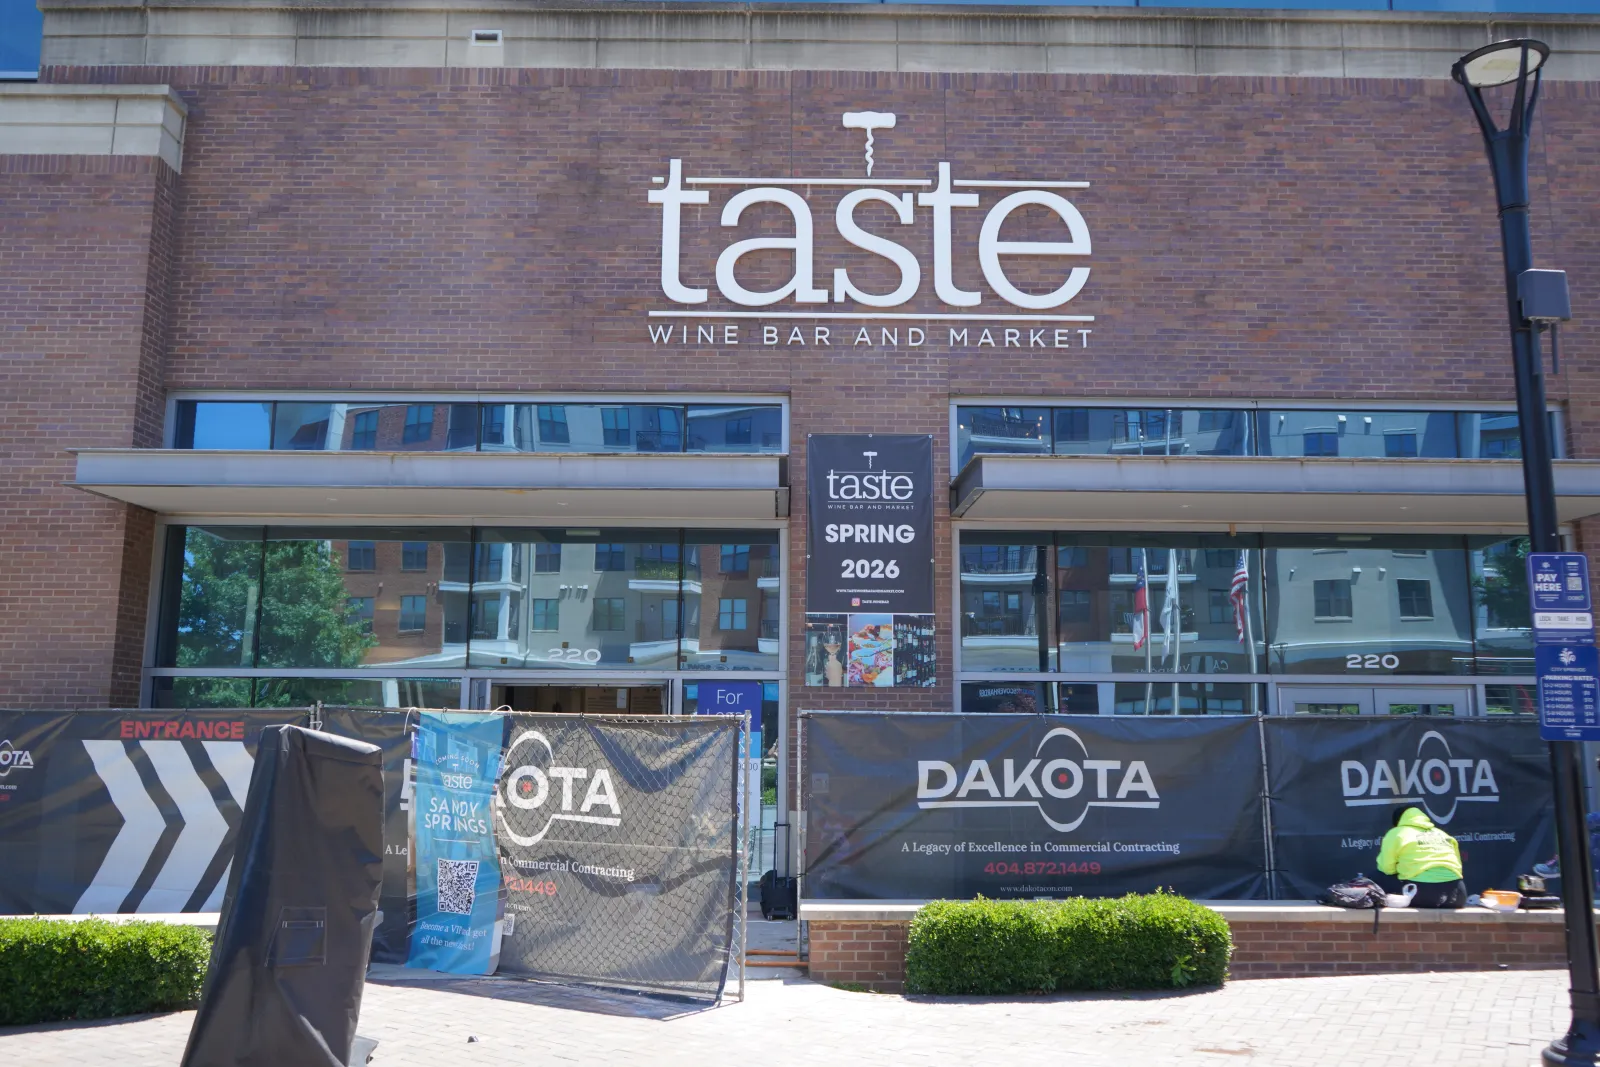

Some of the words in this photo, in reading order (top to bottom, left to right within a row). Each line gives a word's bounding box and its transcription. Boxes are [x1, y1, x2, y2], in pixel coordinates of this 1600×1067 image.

[648, 158, 1092, 310] taste
[648, 325, 739, 345] WINE
[763, 327, 831, 346] BAR
[854, 328, 926, 347] AND
[950, 329, 1093, 349] MARKET
[826, 469, 914, 500] taste
[825, 523, 916, 544] SPRING
[841, 558, 901, 579] 2026
[1536, 573, 1558, 582] PAY
[1534, 583, 1562, 592] HERE
[548, 648, 602, 663] 220
[1346, 653, 1400, 669] 220
[717, 689, 744, 705] For
[120, 720, 245, 739] ENTRANCE
[436, 754, 459, 765] COMING
[461, 756, 480, 769] SOON
[917, 758, 1160, 799] DAKOTA
[1340, 758, 1499, 797] DAKOTA
[430, 797, 480, 818] SANDY
[425, 813, 488, 834] SPRINGS
[901, 842, 910, 852] A
[912, 842, 951, 855] Legacy
[954, 842, 966, 852] of
[968, 842, 1028, 852] Excellence
[1030, 842, 1042, 852] in
[1044, 842, 1111, 853] Commercial
[1113, 842, 1181, 855] Contracting
[1341, 838, 1348, 847] A
[1348, 837, 1373, 850] Legacy
[1374, 837, 1381, 847] of
[1474, 830, 1516, 843] Contracting
[384, 845, 393, 855] A
[395, 845, 408, 855] Le
[508, 856, 569, 873] Commercial
[571, 861, 635, 882] Contracting
[984, 861, 1102, 875] 404.872.1449
[1000, 884, 1073, 893] www.dakotacon.com
[420, 921, 444, 933] Become
[472, 928, 487, 939] get
[430, 936, 444, 946] the
